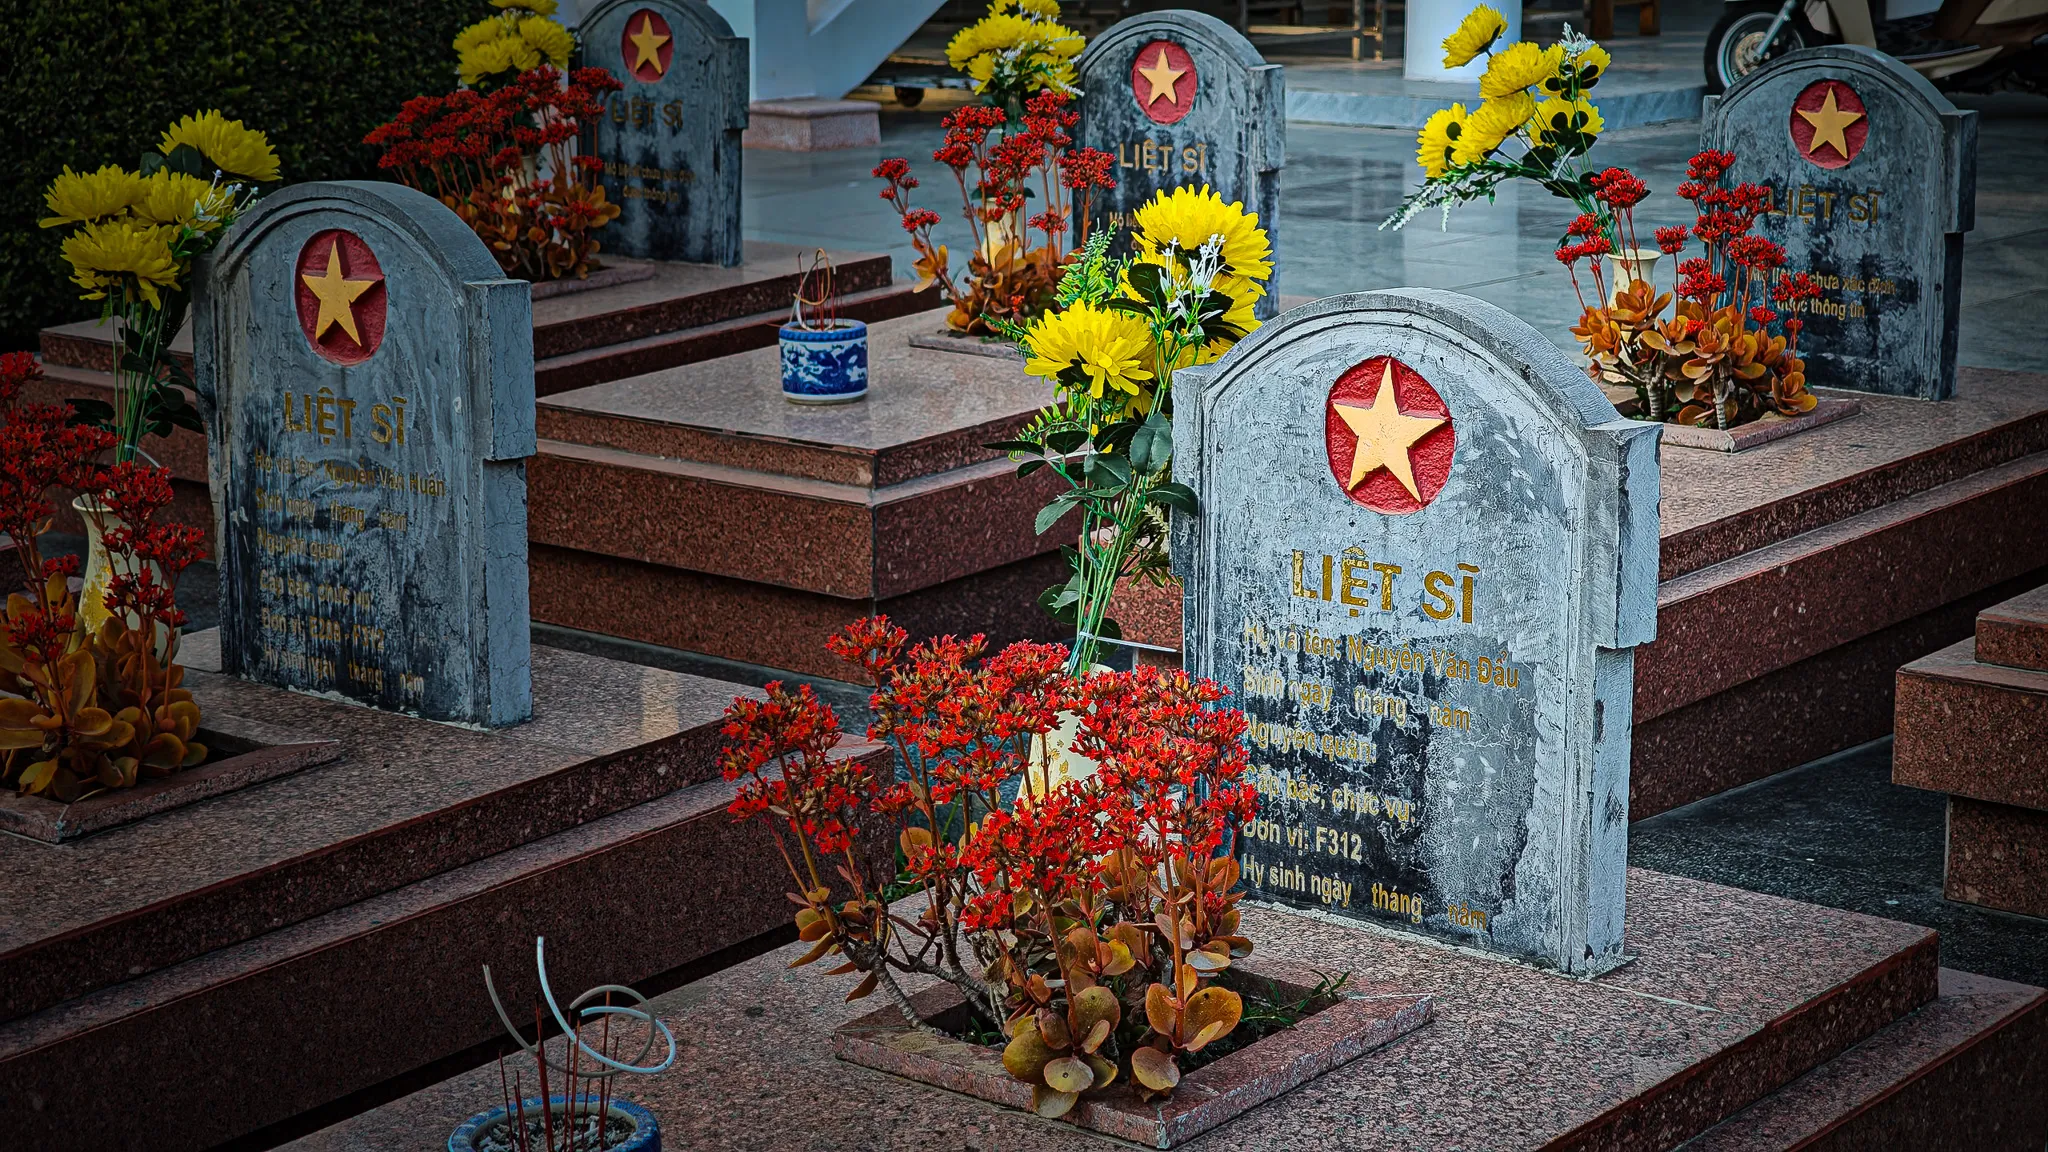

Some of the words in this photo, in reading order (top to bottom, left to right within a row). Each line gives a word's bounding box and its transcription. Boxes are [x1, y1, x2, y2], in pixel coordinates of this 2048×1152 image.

[1119, 138, 1174, 176] LIỆT
[1182, 142, 1207, 173] SĨ
[1767, 184, 1838, 224] LIỆT
[1848, 189, 1884, 225] SĨ
[1810, 298, 1847, 321] thông
[284, 386, 357, 446] LIỆT
[370, 396, 409, 446] SĨ
[1291, 546, 1403, 617] LIỆT
[1421, 562, 1481, 624] SĨ
[1431, 647, 1471, 681] Văn
[1429, 701, 1472, 733] năm
[1286, 822, 1309, 856] vị:
[1315, 825, 1363, 864] F312
[1242, 852, 1265, 889] Hy
[1269, 861, 1306, 894] sinh
[1311, 871, 1353, 908] ngày
[1371, 883, 1423, 923] tháng
[1447, 902, 1488, 931] năm
